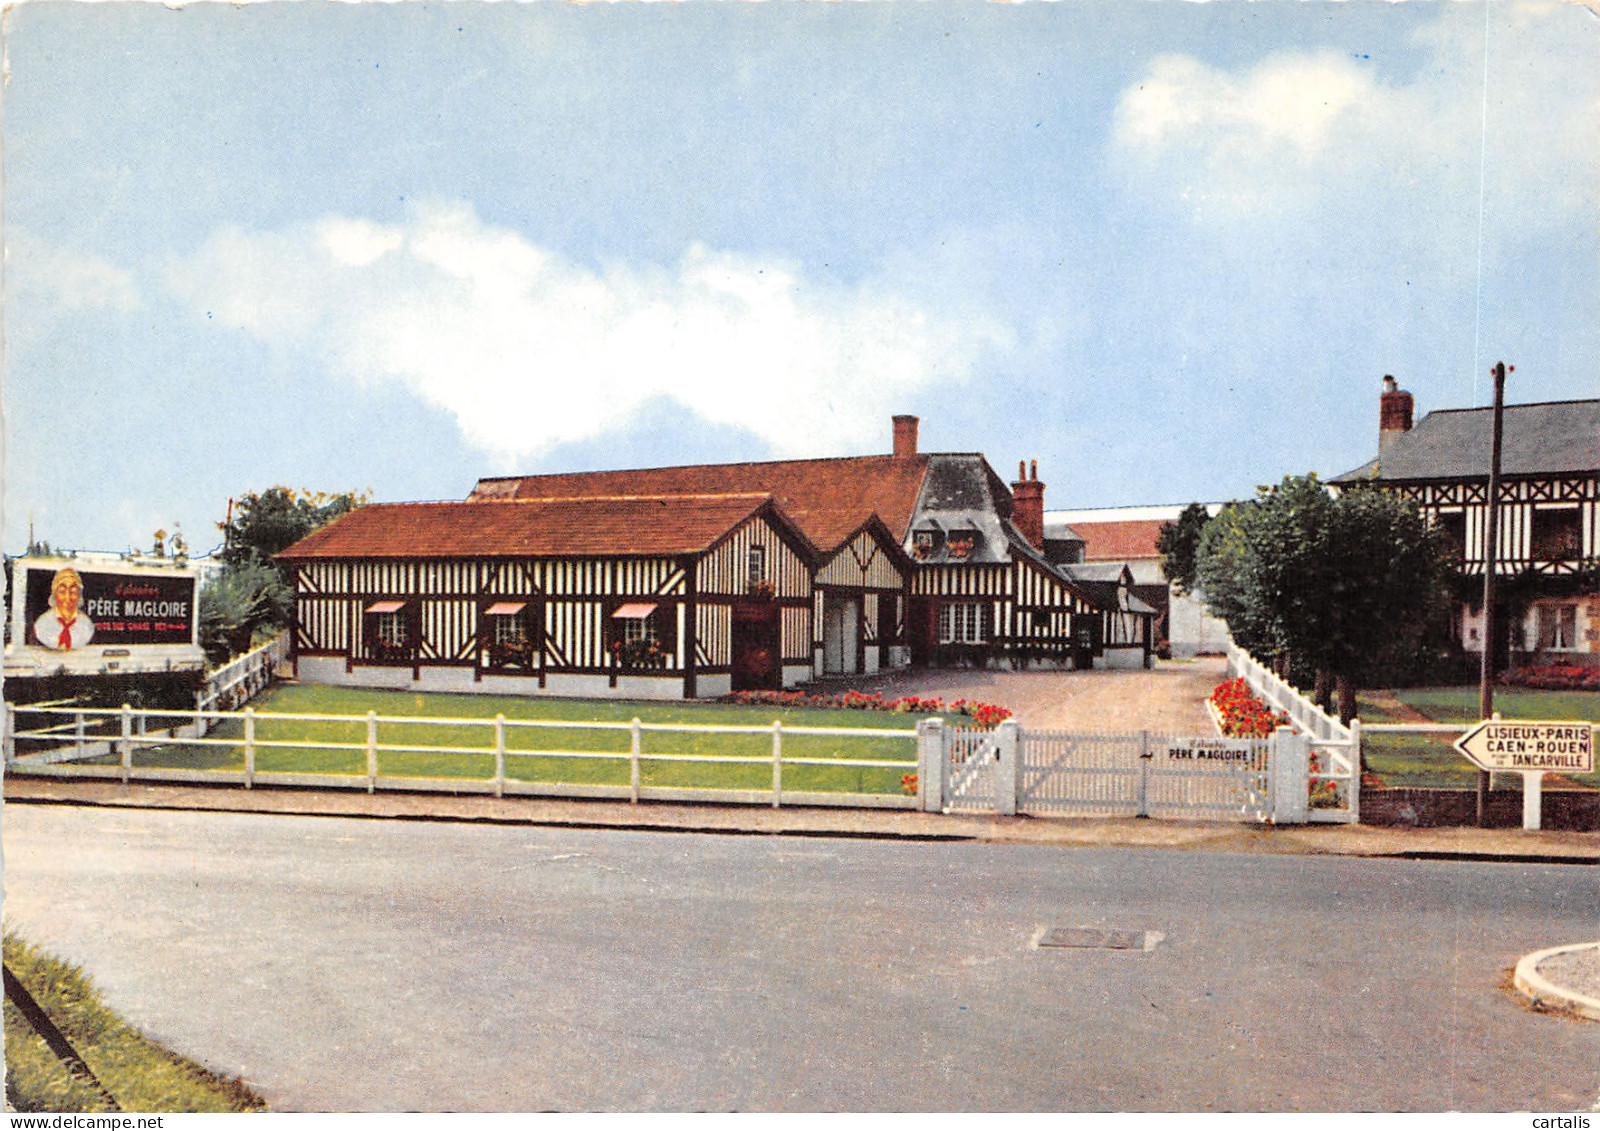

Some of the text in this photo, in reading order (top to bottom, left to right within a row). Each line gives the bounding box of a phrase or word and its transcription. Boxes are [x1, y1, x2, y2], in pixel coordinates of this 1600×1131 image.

[87, 597, 188, 618] PÈRE MAGLOIRE
[1486, 727, 1589, 740] LISIEUX-PARIS
[1197, 749, 1248, 761] MAGLOIRE
[1512, 754, 1583, 767] TANCARVILLE
